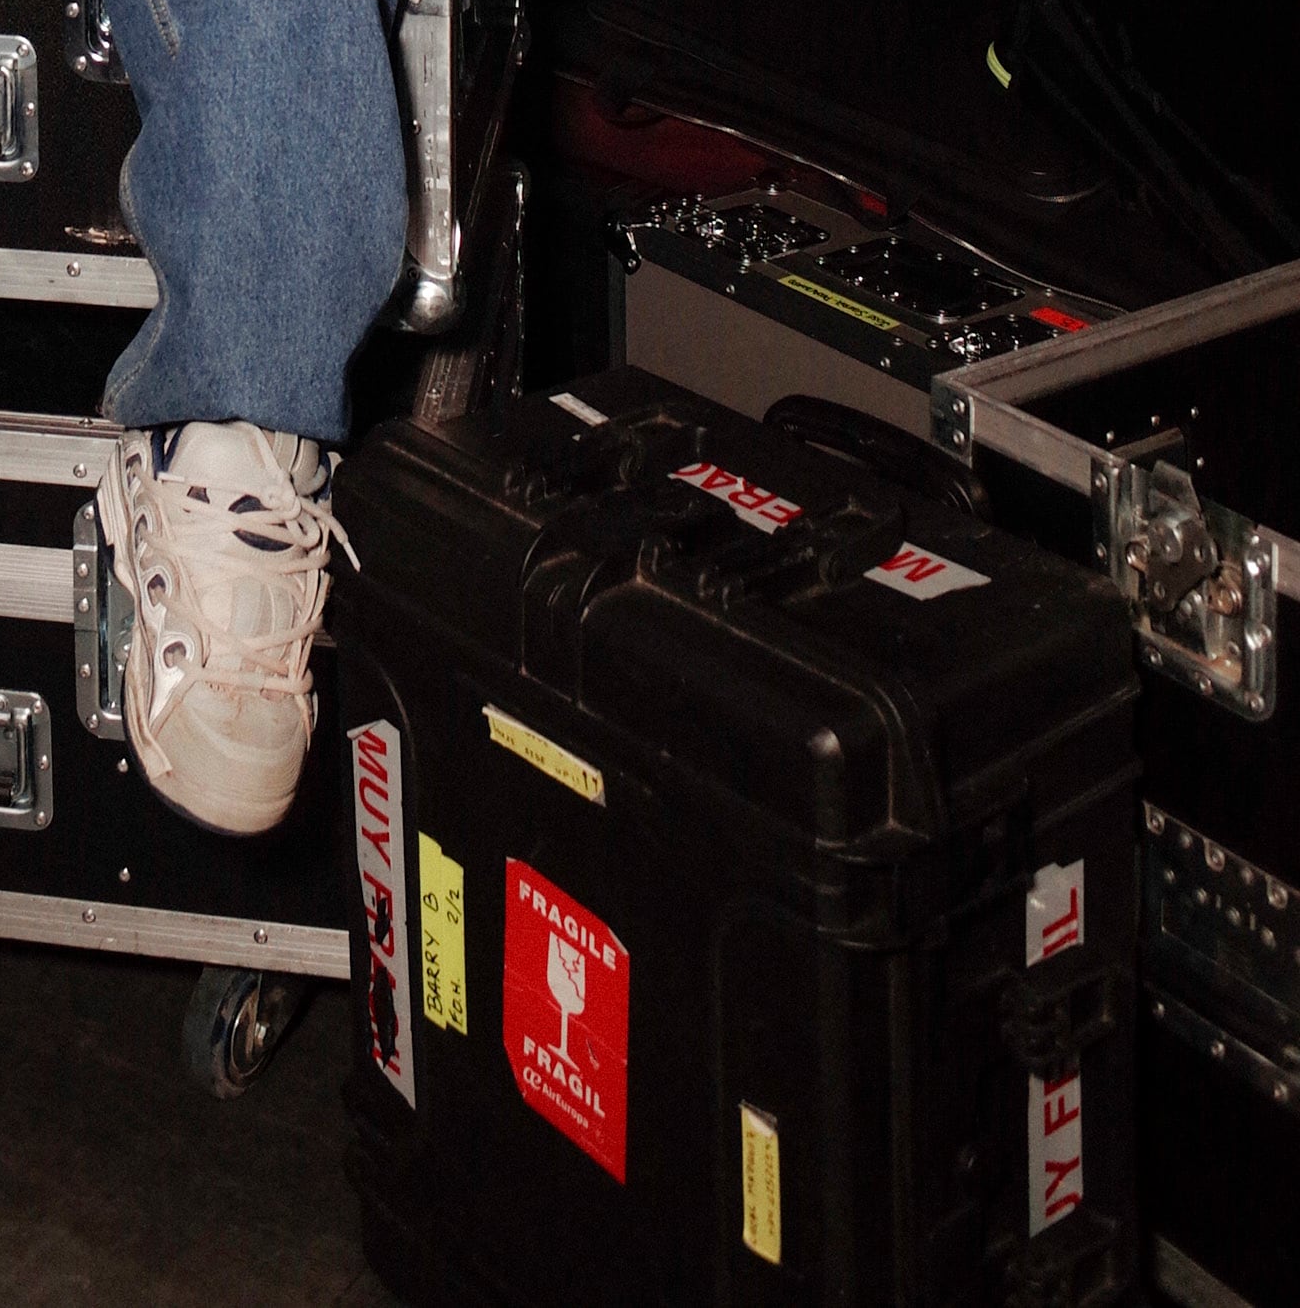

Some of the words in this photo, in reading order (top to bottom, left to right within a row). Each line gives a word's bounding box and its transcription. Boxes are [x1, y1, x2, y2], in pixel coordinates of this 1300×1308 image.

[357, 731, 392, 870] MUY
[423, 891, 440, 913] B
[445, 888, 463, 925] 2/2
[519, 879, 617, 972] FRAGILE
[423, 929, 444, 1016] BARRY
[523, 1035, 606, 1119] FRAGIL
[542, 1083, 589, 1129] AirEuropa
